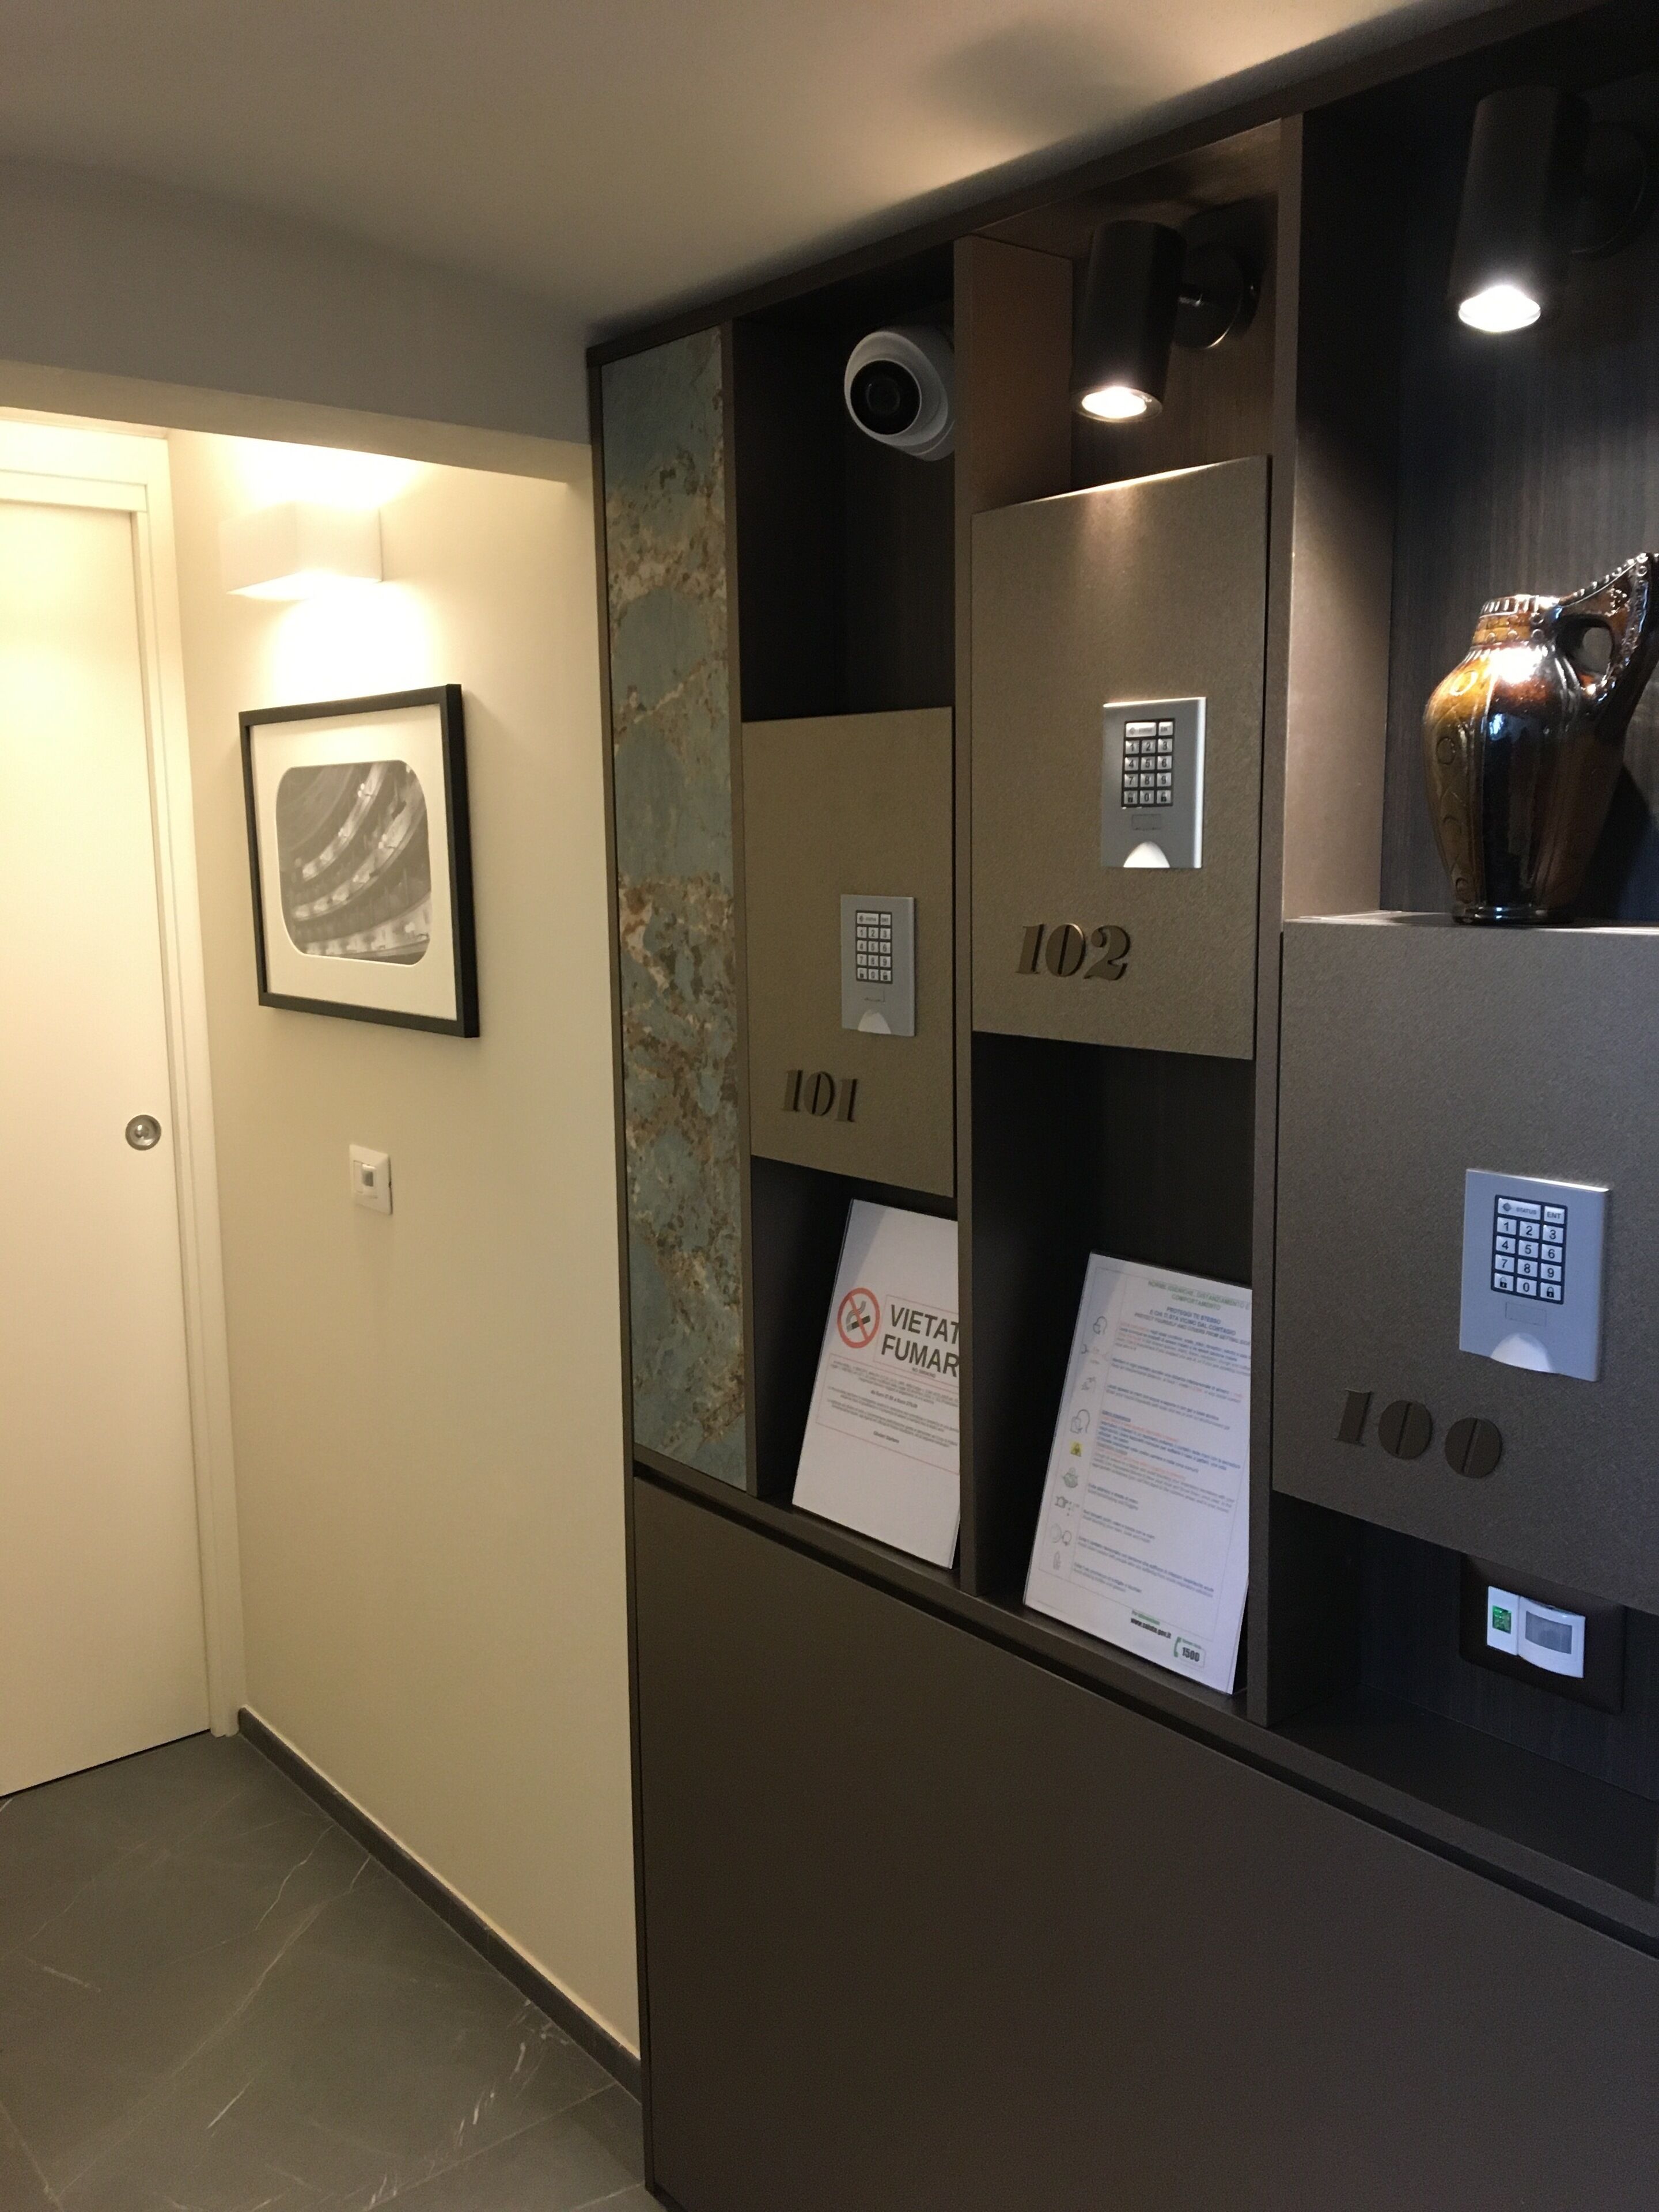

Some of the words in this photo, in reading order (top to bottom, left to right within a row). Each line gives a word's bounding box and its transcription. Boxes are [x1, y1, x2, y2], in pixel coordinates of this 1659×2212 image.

[1016, 923, 1131, 980] 102
[781, 1070, 859, 1122] 101
[1516, 1207, 1537, 1215] STATUS
[1547, 1211, 1562, 1219] ENT
[1503, 1222, 1509, 1232] 1
[1525, 1225, 1533, 1236] 2
[1549, 1229, 1556, 1240] 3
[1502, 1240, 1509, 1250] 4
[1525, 1244, 1532, 1255] 5
[1548, 1249, 1555, 1259] 6
[1502, 1259, 1508, 1268] 7
[1524, 1263, 1531, 1274] 8
[1547, 1267, 1554, 1278] 9
[1522, 1282, 1530, 1292] 0
[881, 1334, 959, 1377] FUMAR
[1333, 1388, 1503, 1479] 100
[1182, 1646, 1200, 1662] 1500
